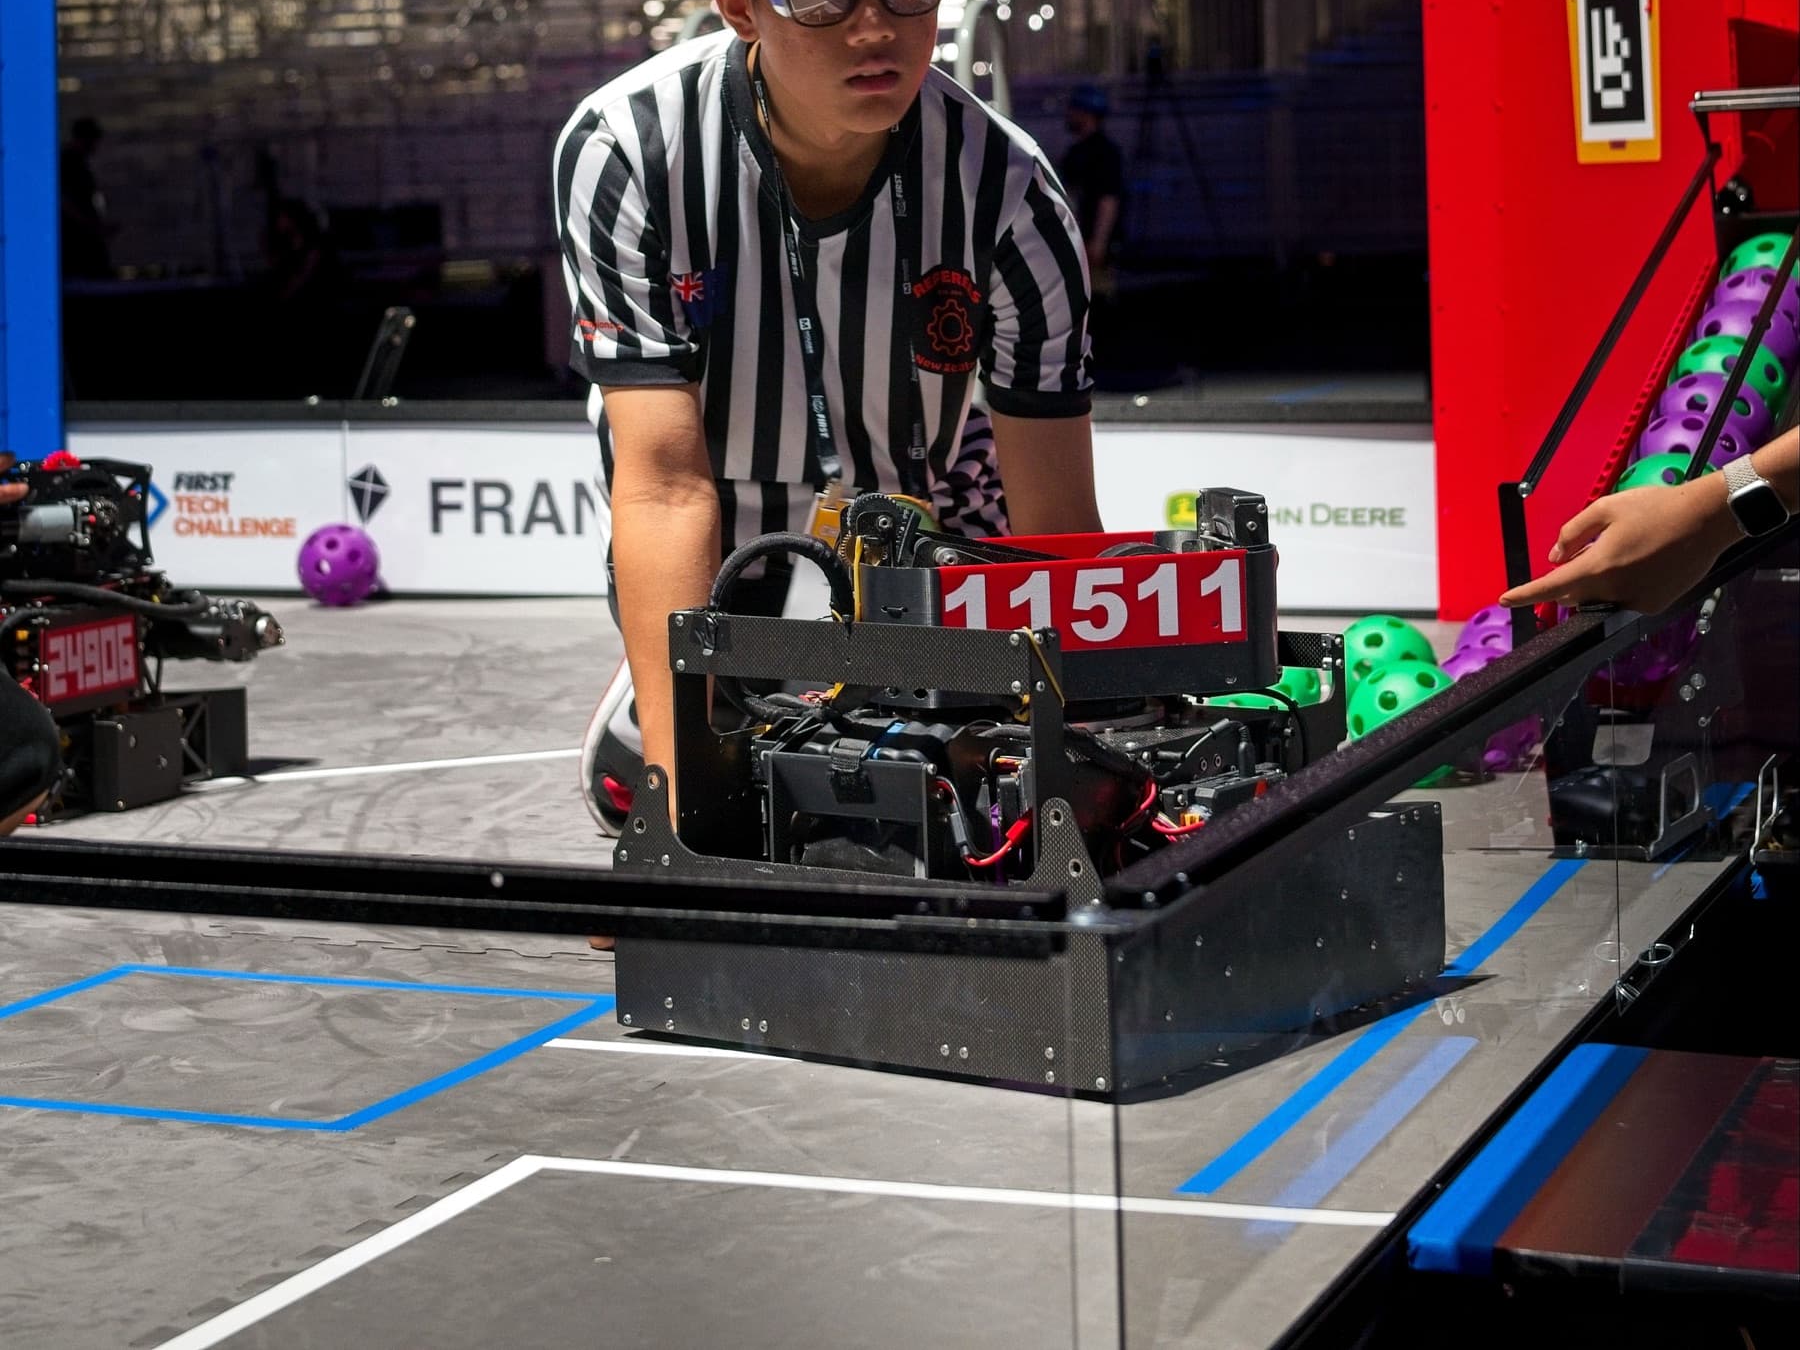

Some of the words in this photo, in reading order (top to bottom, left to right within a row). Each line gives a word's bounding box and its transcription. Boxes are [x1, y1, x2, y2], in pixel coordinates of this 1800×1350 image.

[174, 471, 235, 491] FIRST
[175, 495, 229, 514] TECH
[429, 479, 597, 535] FRAN
[1308, 502, 1406, 527] DEERE
[174, 517, 297, 538] CHALLENGE
[944, 559, 1242, 643] 11511
[46, 620, 138, 697] 24906
